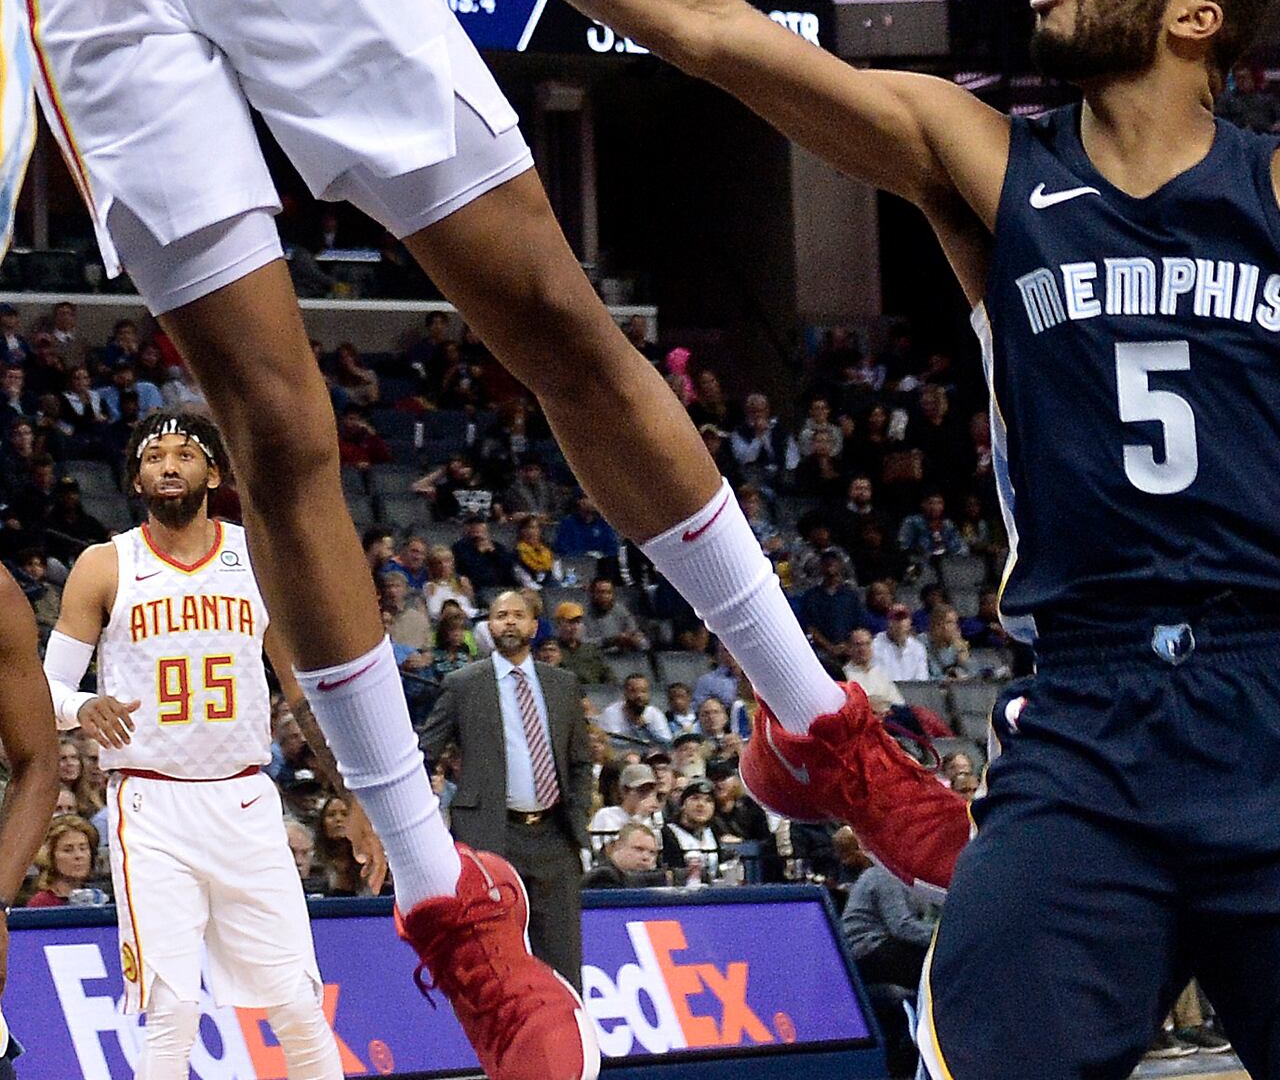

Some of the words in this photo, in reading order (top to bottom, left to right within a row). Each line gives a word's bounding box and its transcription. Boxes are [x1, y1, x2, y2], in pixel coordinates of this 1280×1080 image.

[1114, 339, 1199, 495] 5
[129, 594, 255, 645] ATLANTA
[156, 652, 237, 726] 95
